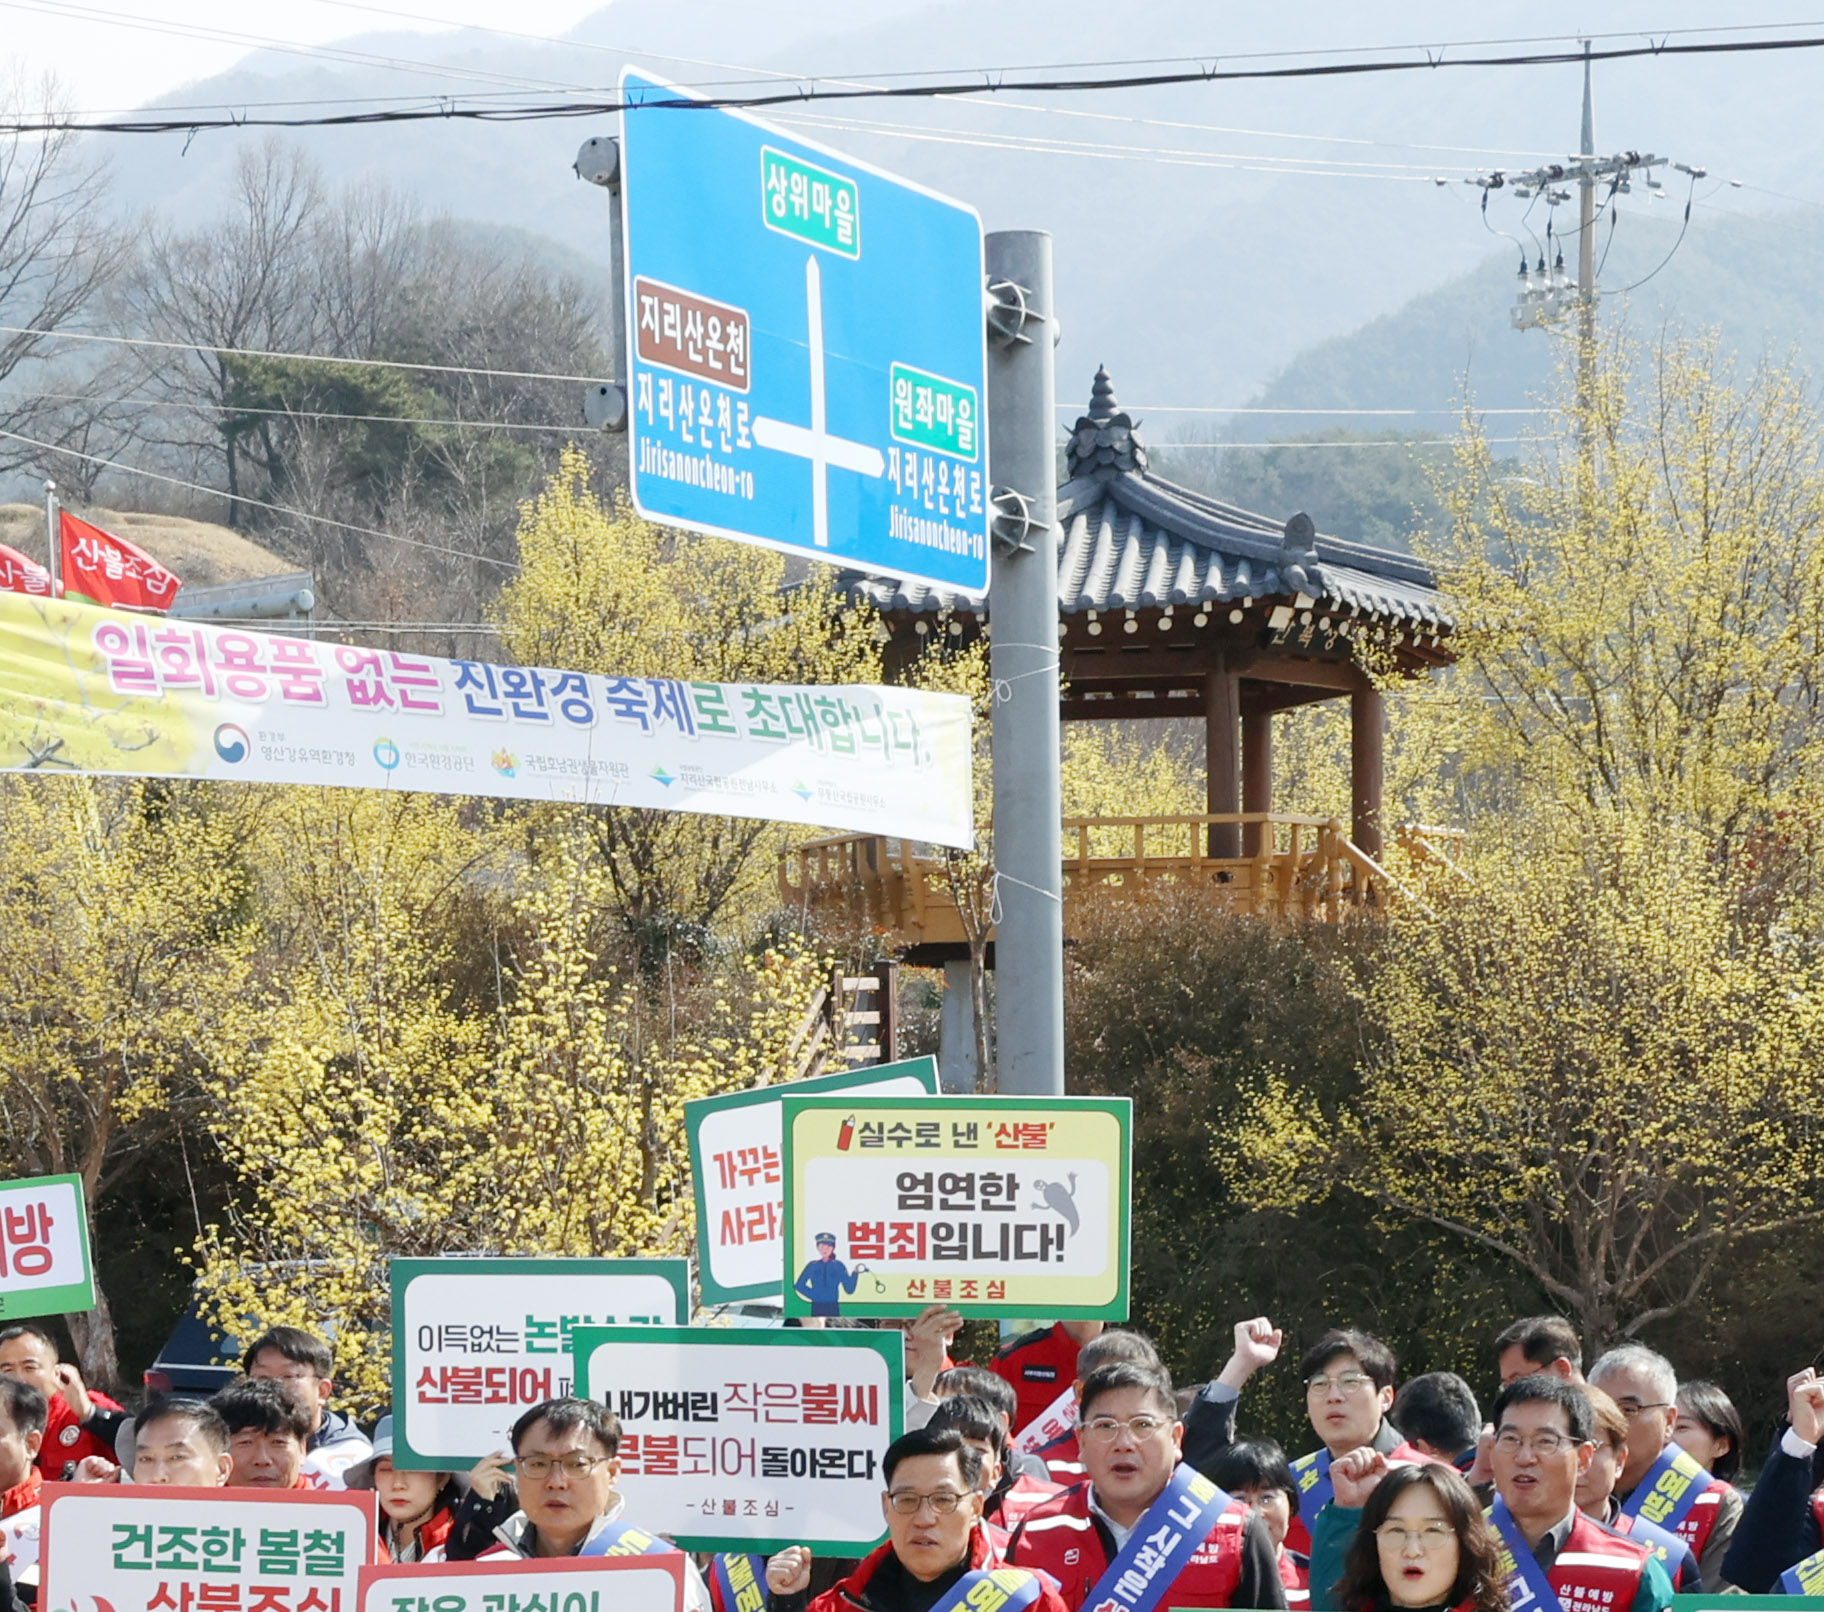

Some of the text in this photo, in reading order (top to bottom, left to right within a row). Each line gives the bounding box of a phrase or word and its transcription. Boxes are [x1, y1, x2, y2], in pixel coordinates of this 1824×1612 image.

[766, 163, 855, 247] 상위마을
[640, 294, 746, 379] 지리산온천
[638, 372, 753, 450] 지리산온천로
[894, 378, 975, 449] 원좌마을
[639, 436, 754, 501] Jirisanoncheon-ro
[888, 446, 983, 516] 지리산온천로
[889, 505, 984, 561] Jirisanoncheon-ro
[71, 537, 172, 595] 산불조심
[95, 625, 324, 703] 일회용품
[335, 646, 440, 711] 없는
[858, 1122, 941, 1149] 실수로
[952, 1122, 978, 1148] 낸
[896, 1172, 1019, 1212] 엄연한
[720, 1200, 783, 1246] 사라
[848, 1222, 1065, 1263] 범죄입니다!
[906, 1280, 1006, 1300] 산불조심
[418, 1325, 519, 1354] 이득없는
[416, 1366, 552, 1406] 산불되어
[606, 1383, 878, 1425] 내가버린 작은불씨
[760, 1446, 876, 1481] 돌아온다
[111, 1524, 346, 1577] 건조한 봄철
[1119, 1524, 1182, 1603] 시작은
[1560, 1584, 1613, 1603] 산불예방
